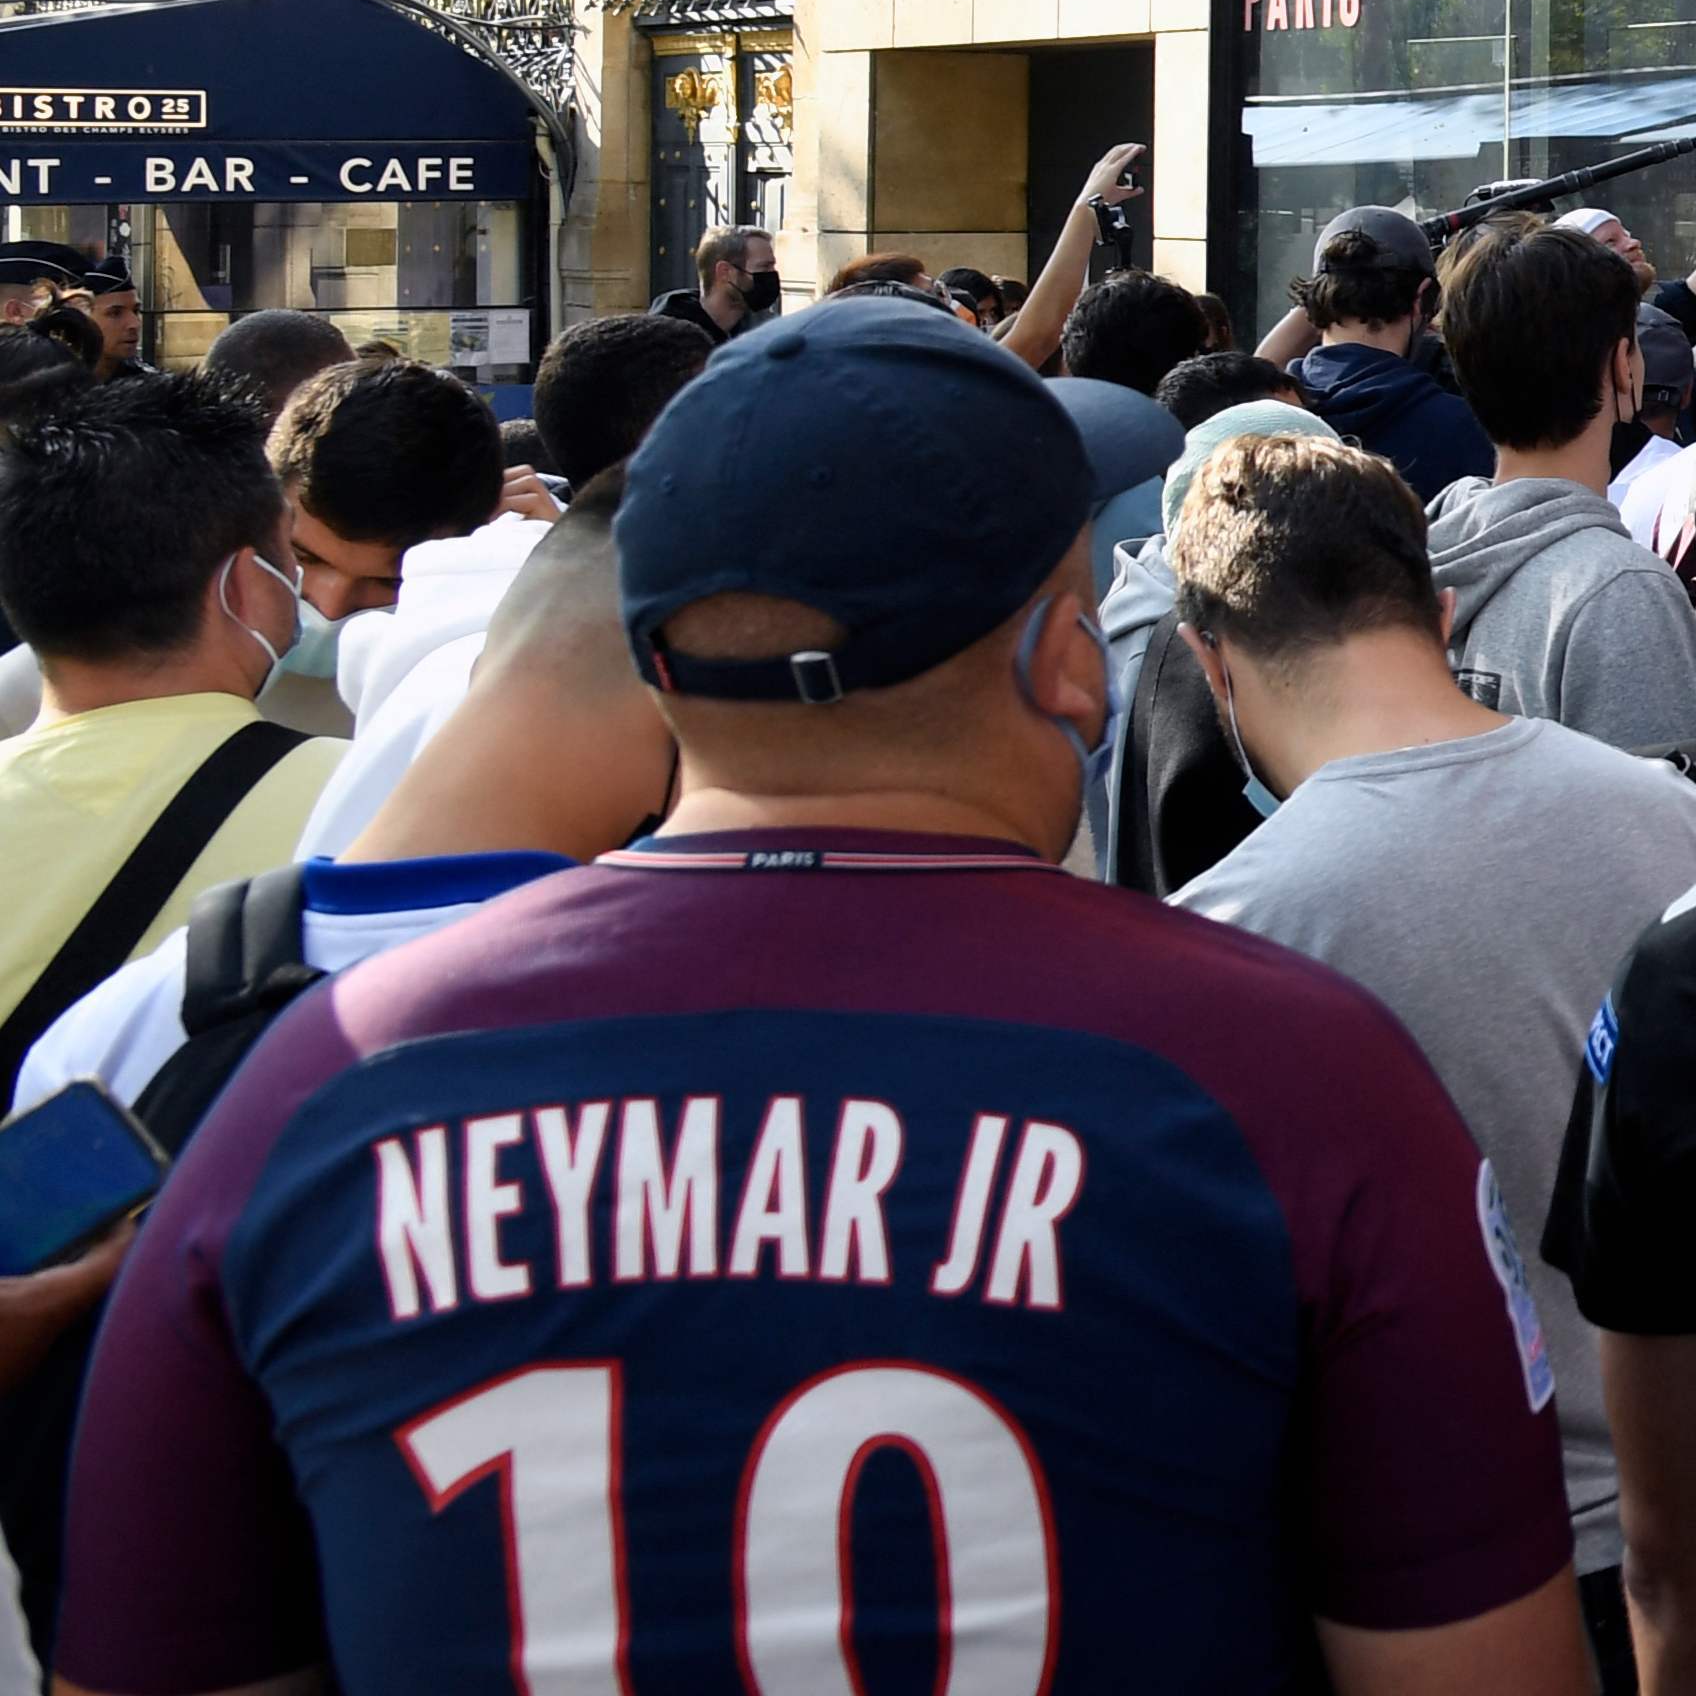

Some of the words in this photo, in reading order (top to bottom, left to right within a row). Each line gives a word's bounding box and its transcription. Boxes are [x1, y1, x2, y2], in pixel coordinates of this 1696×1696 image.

[0, 95, 152, 120] ISTRO
[161, 98, 191, 114] 25
[2, 126, 48, 134] BISTRO
[83, 127, 133, 135] CHAMPS
[145, 157, 255, 193] BAR
[339, 157, 475, 192] CAFE
[751, 852, 816, 868] PARIS
[373, 1094, 904, 1322] NEYMAR
[930, 1113, 1086, 1313] JR
[394, 1357, 1062, 1696] 10
